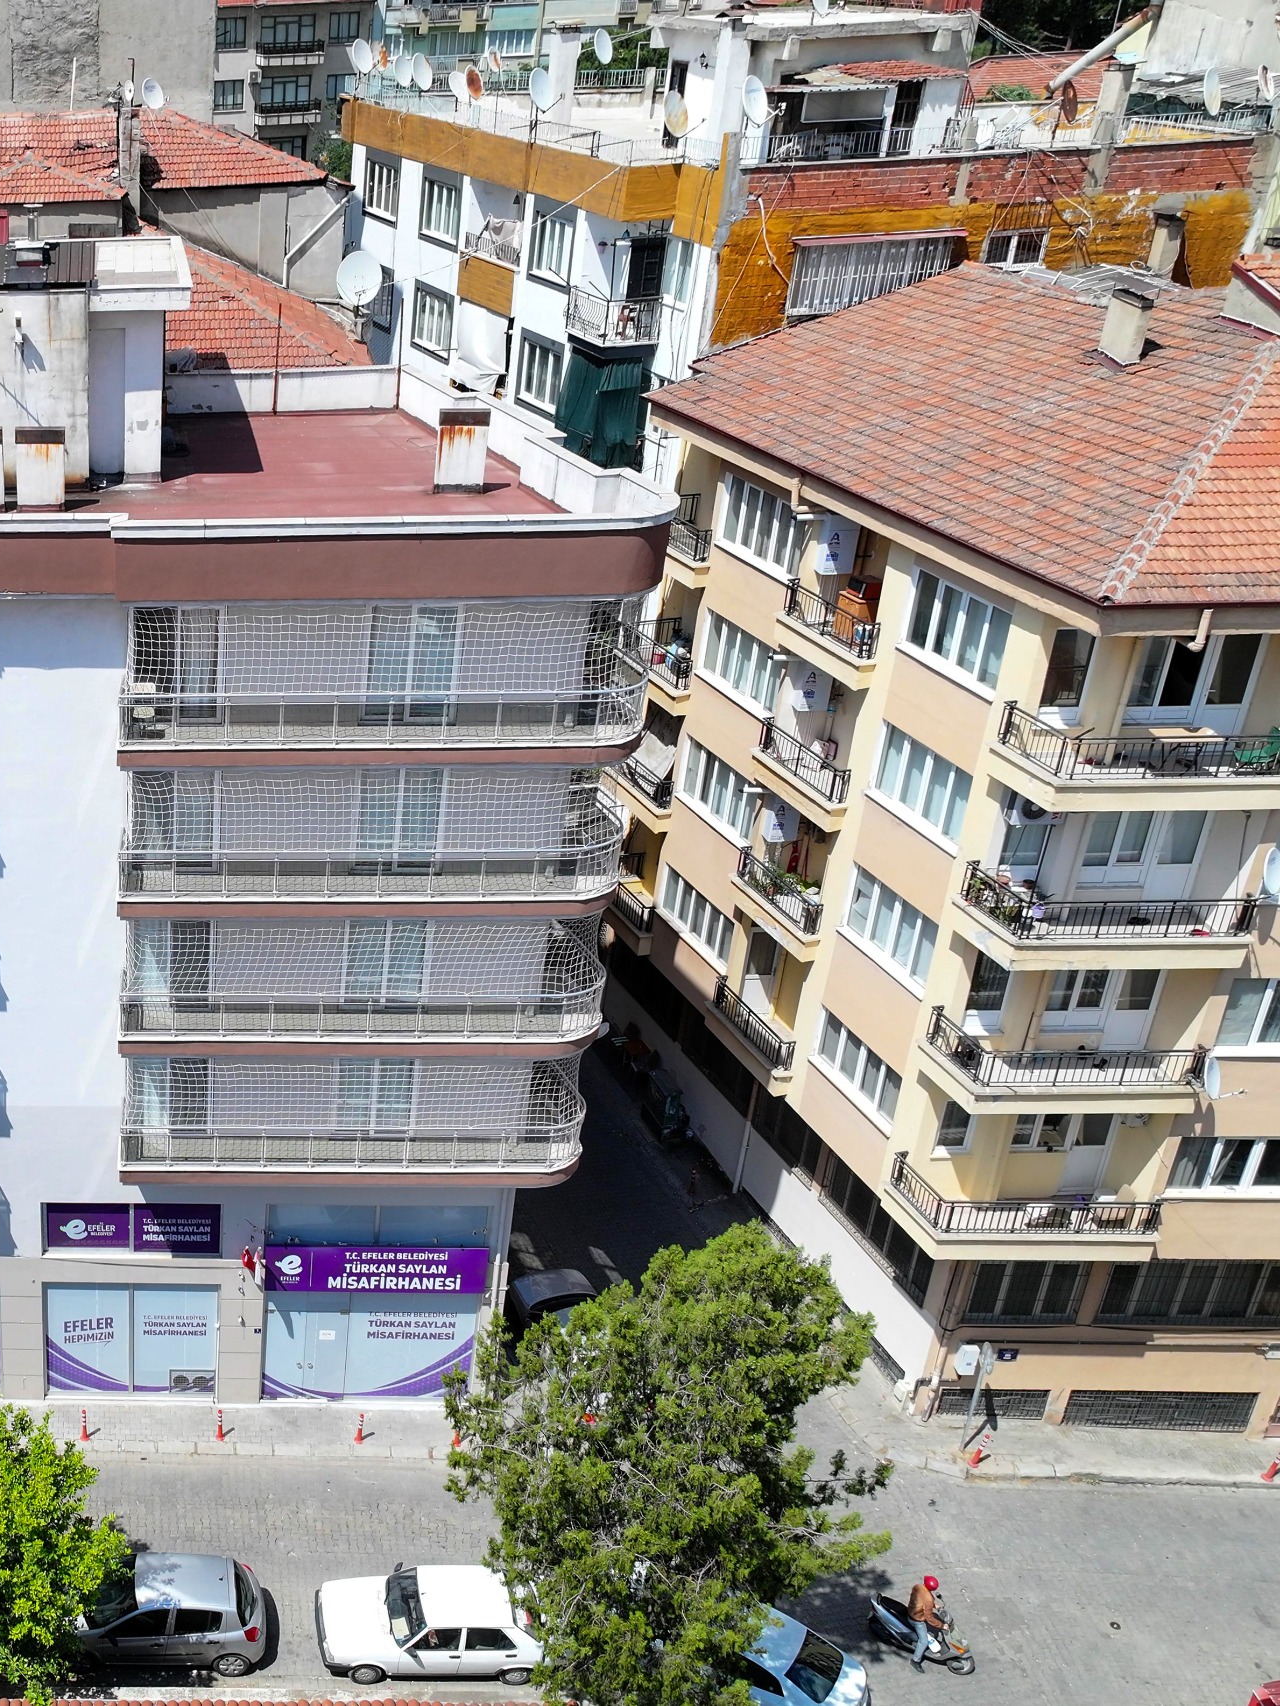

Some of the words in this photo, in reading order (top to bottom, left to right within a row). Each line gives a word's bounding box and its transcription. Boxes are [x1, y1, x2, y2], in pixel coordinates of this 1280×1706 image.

[143, 1233, 210, 1241] MİSAFİRHANESİ
[362, 1252, 395, 1260] EFELER
[397, 1251, 448, 1260] BELEDİYESİ
[345, 1263, 396, 1273] TÜRKAN
[399, 1264, 446, 1274] SAYLAN
[328, 1274, 461, 1290] MİSAFİRHANESİ
[64, 1317, 114, 1333] EFELER
[368, 1319, 412, 1328] TÜRKAN
[414, 1320, 456, 1328] SAYLAN
[64, 1331, 114, 1344] HEPİMİZİN
[367, 1330, 455, 1340] MİSAFİRHANESİ
